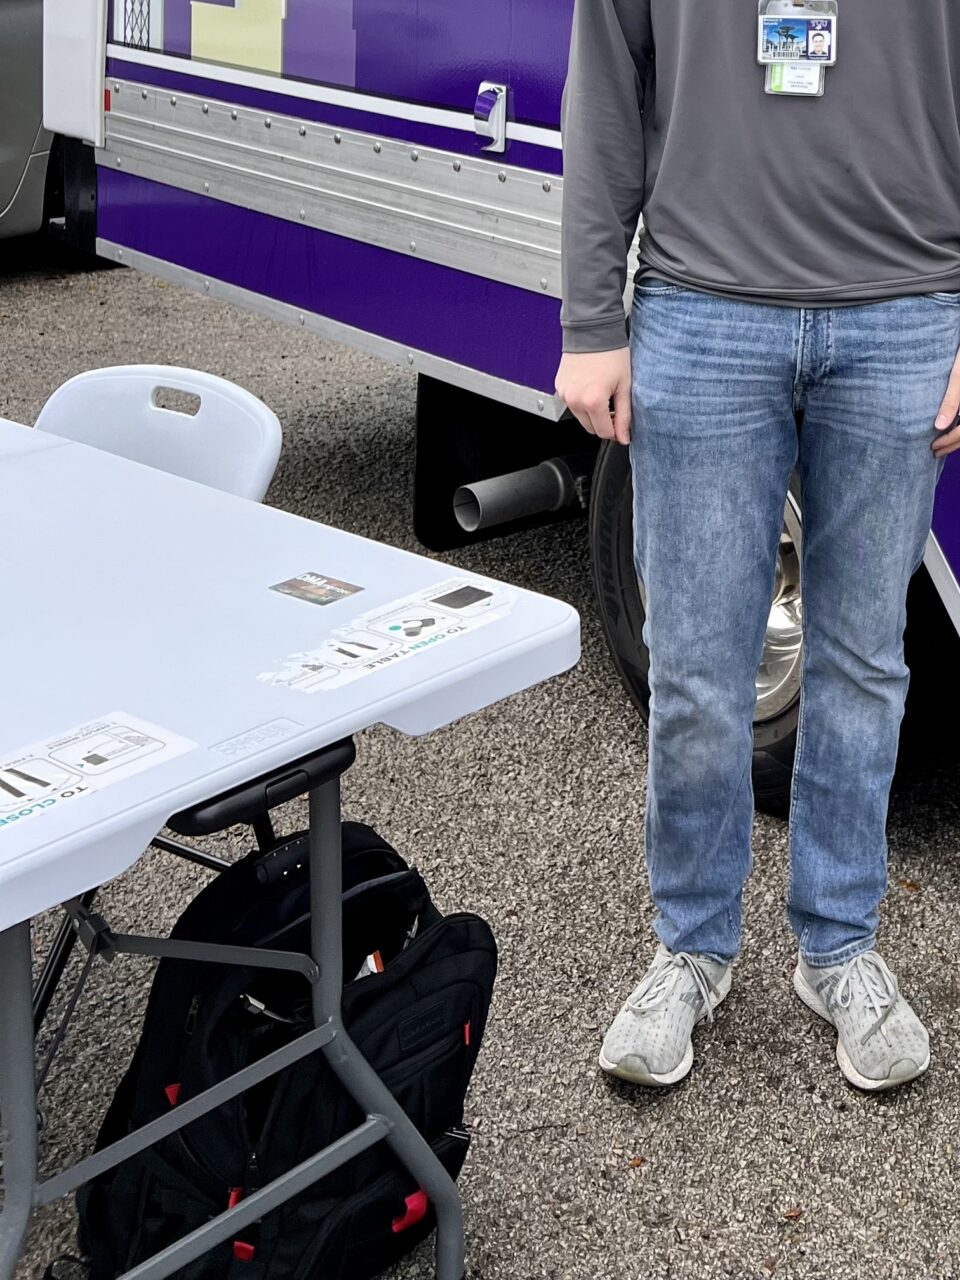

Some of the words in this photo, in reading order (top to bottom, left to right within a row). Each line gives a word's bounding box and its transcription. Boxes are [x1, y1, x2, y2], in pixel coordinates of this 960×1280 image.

[446, 625, 468, 634] TO
[409, 634, 446, 651] OPEN
[363, 649, 410, 670] TABLE
[60, 786, 89, 798] TO
